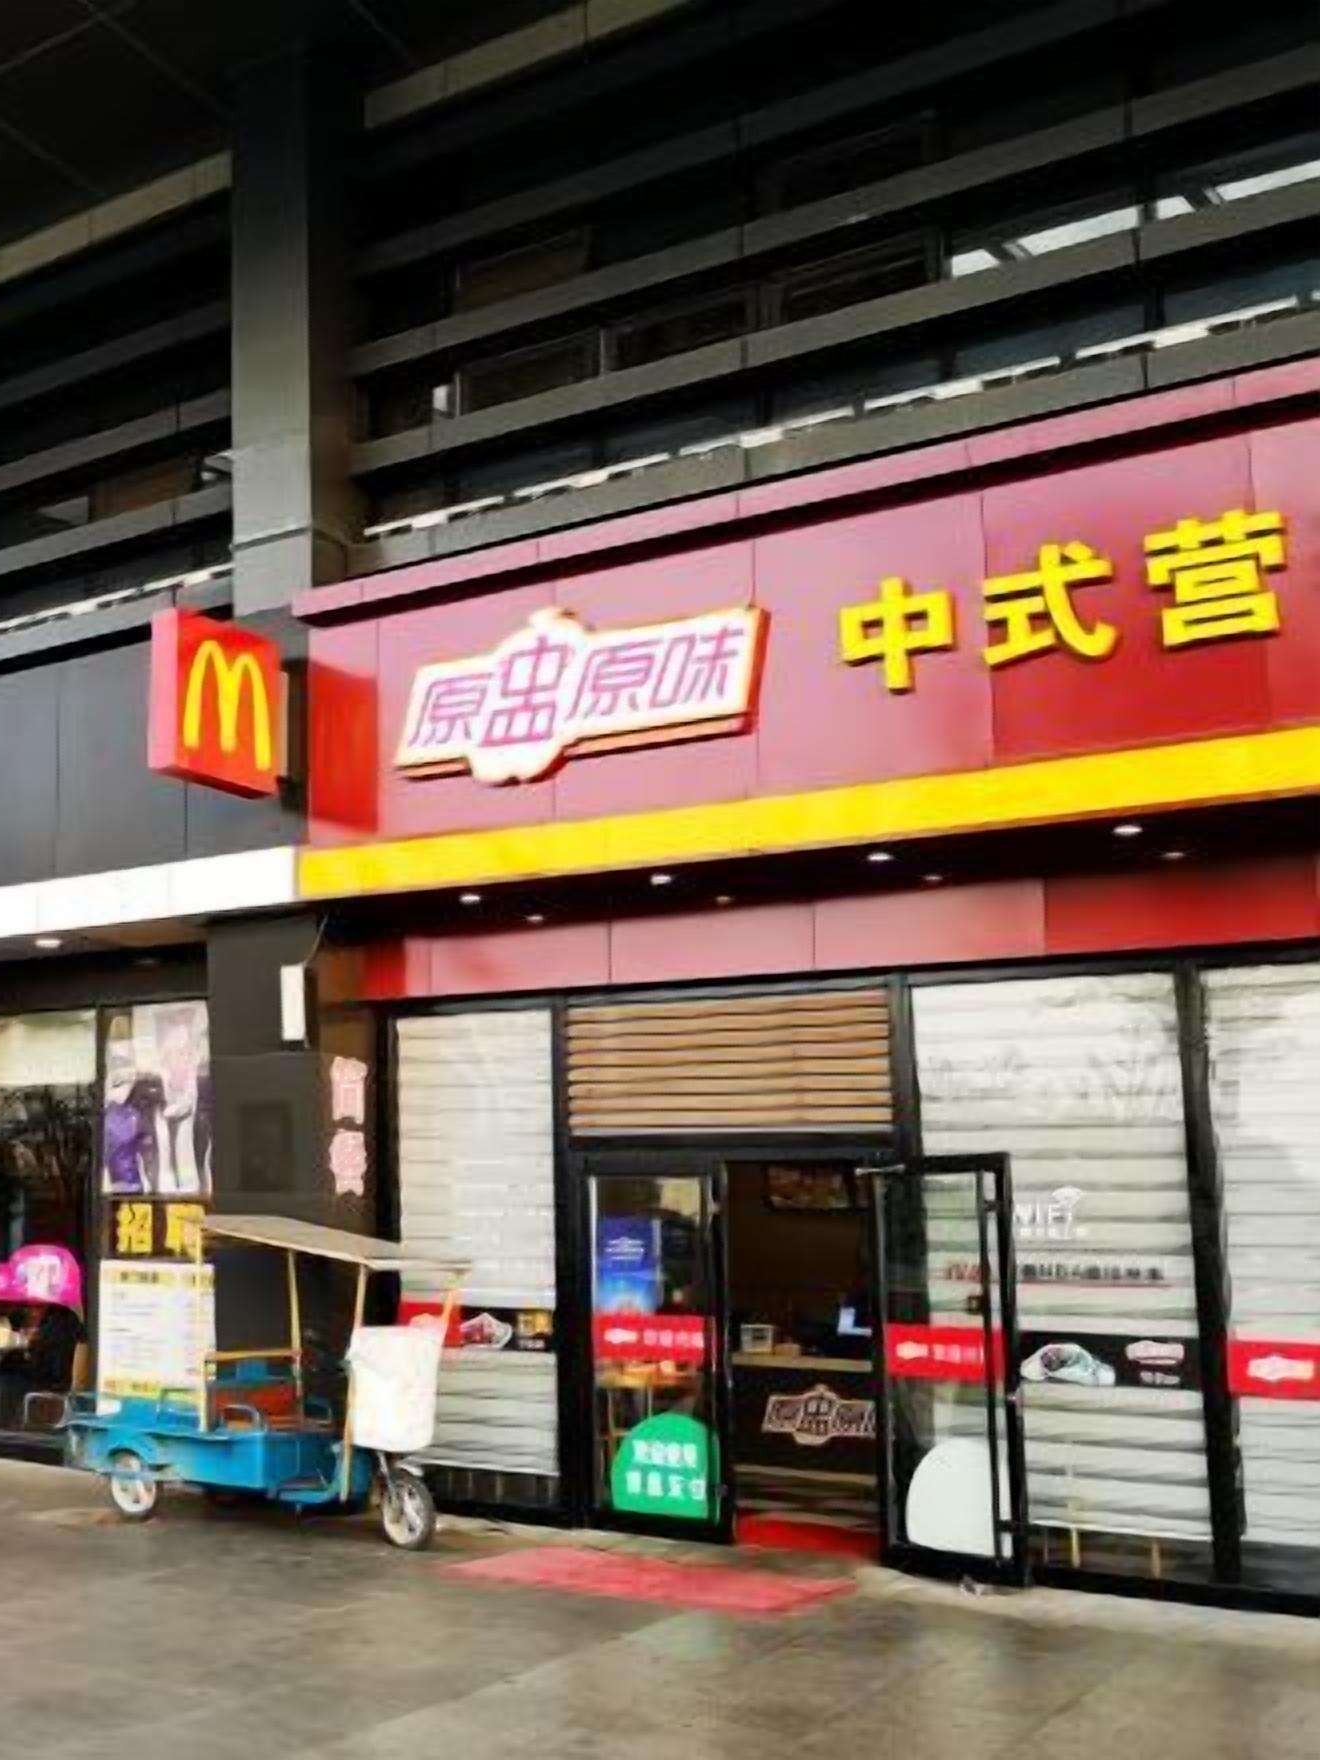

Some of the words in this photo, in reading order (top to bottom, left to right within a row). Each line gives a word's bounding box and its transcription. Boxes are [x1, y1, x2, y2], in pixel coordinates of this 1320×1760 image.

[840, 509, 1285, 693] 中式营
[408, 627, 744, 748] 原盅原味
